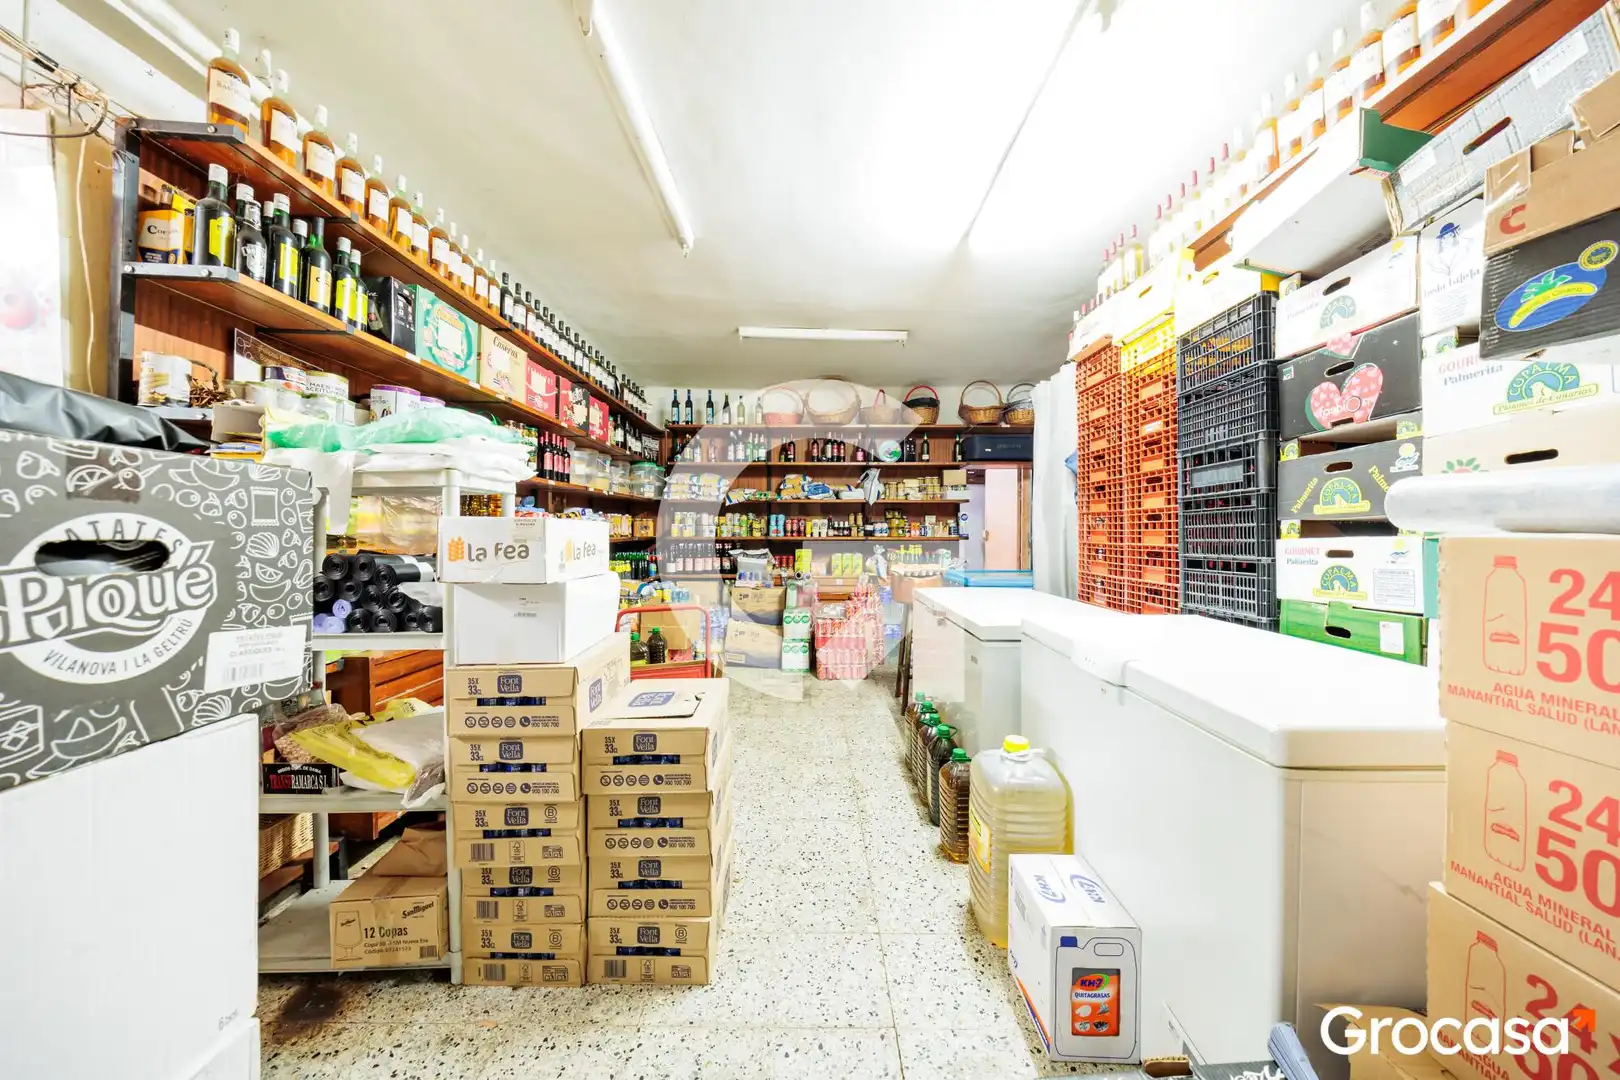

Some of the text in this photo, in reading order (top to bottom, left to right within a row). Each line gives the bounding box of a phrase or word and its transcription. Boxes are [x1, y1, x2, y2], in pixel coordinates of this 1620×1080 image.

[1438, 354, 1481, 374] GOUR
[1443, 364, 1504, 386] Palmerita
[1509, 362, 1577, 396] COPALMA
[1291, 477, 1318, 513] Palmerita
[1322, 479, 1359, 502] COPALMA
[64, 518, 184, 556] ATATES
[467, 541, 530, 562] la fea
[573, 540, 596, 560] la fea
[1286, 558, 1319, 566] Palmerita
[1321, 567, 1358, 587] COPALMA
[43, 617, 194, 676] VILANOVA I LA GELTRÚ
[500, 677, 519, 685] Font
[500, 684, 519, 692] Vella
[1446, 684, 1522, 713] MANANTIAL
[1527, 702, 1578, 725] SALUD
[1493, 682, 1620, 721] AGUA MINERAL
[636, 735, 654, 743] Font
[501, 743, 520, 751] Font
[501, 750, 520, 759] Vella
[507, 809, 526, 817] Font
[640, 805, 659, 813] Vella
[1548, 780, 1620, 848] 24
[507, 816, 527, 825] Vella
[641, 861, 659, 869] Font
[512, 867, 530, 876] Font
[641, 868, 659, 876] Vella
[512, 875, 530, 884] Vella
[1450, 860, 1620, 961] MANANTIAL SALUD (LAN
[1493, 872, 1617, 944] AGUA MINERAL
[364, 926, 408, 939] 12 Copas
[640, 928, 658, 936] Font
[513, 939, 530, 947] Vella
[640, 935, 658, 943] Vella
[1074, 991, 1110, 999] QUITAGRASAS
